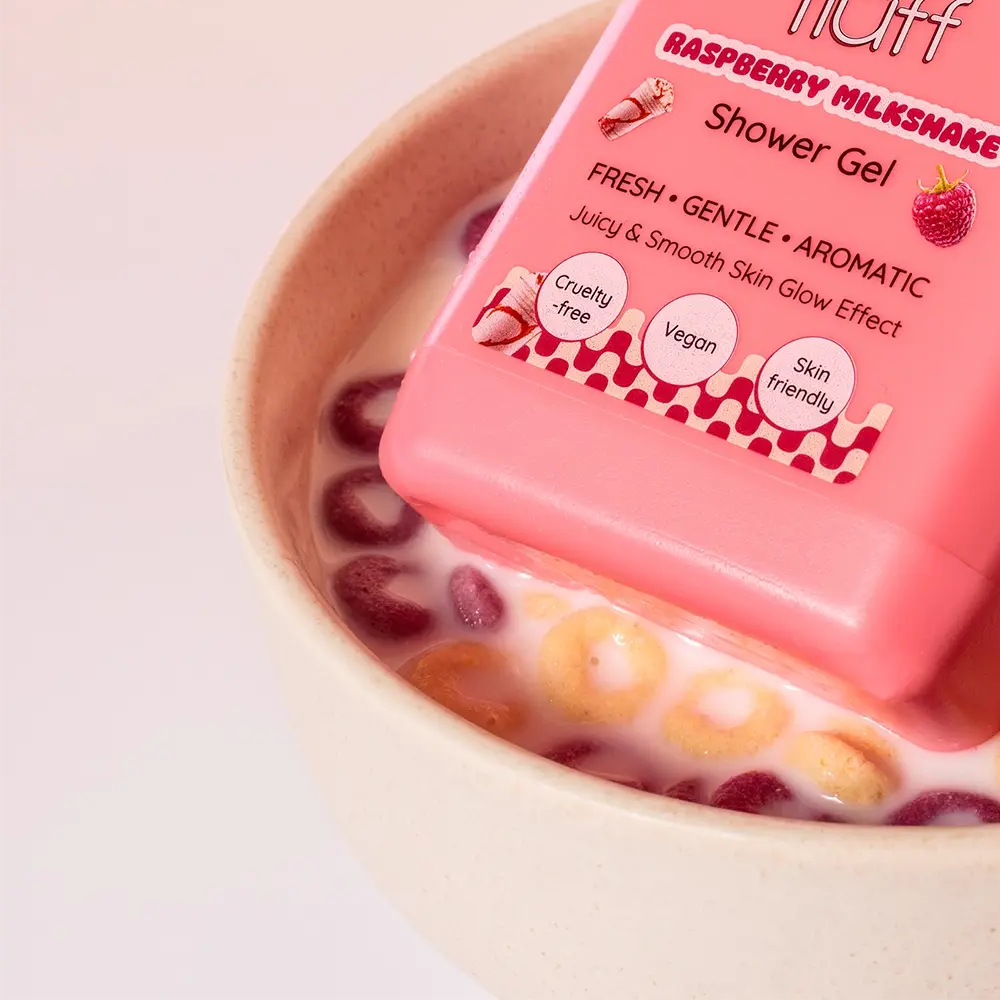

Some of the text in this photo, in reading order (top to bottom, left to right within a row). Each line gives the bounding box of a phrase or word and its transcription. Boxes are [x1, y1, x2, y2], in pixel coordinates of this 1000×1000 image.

[663, 30, 831, 99] RASPBERRY
[704, 102, 898, 188] Shower Gel
[586, 162, 931, 299] FRESH GENTLE AROMATIC
[554, 274, 614, 309] Cruelty
[569, 204, 903, 339] Juicy & Smooth Skin Glow Effect
[551, 299, 592, 326] -free
[664, 321, 718, 356] Vegan
[793, 357, 831, 383] Skin
[767, 373, 835, 415] friendly
